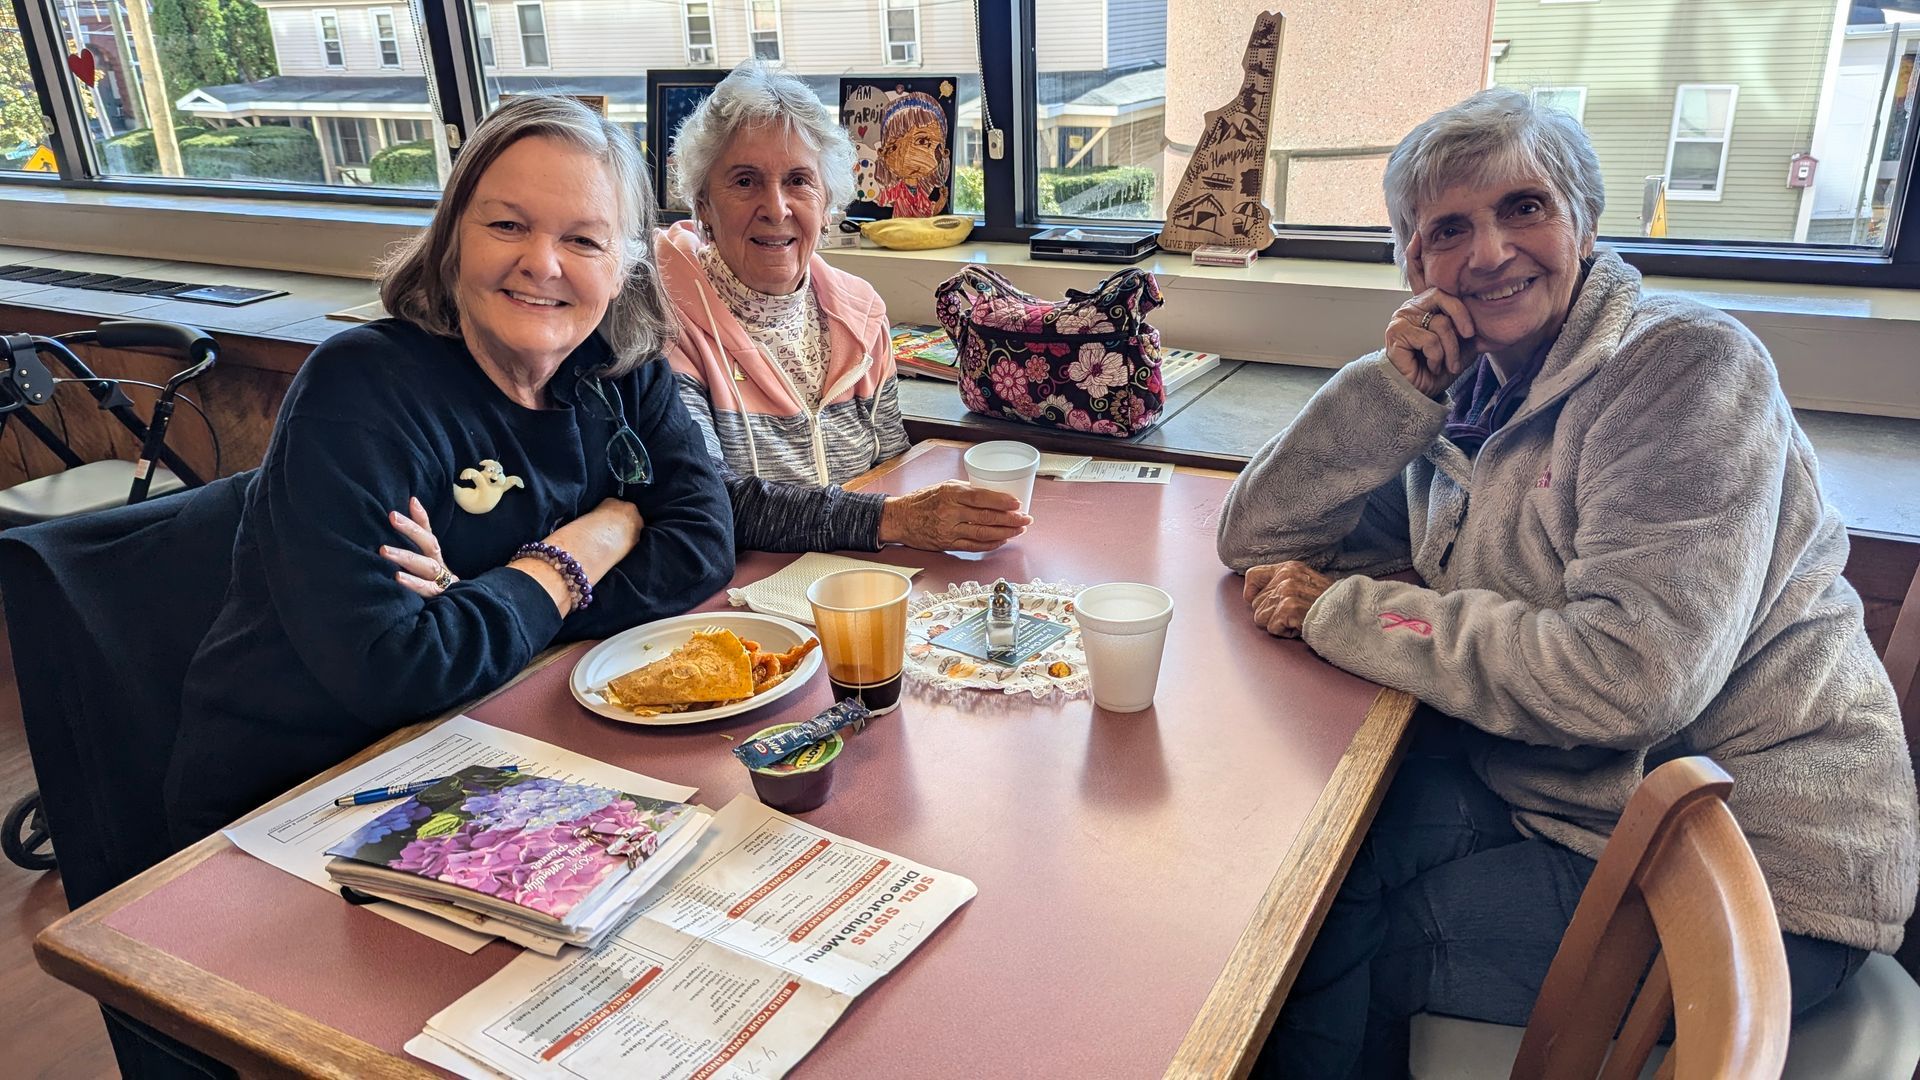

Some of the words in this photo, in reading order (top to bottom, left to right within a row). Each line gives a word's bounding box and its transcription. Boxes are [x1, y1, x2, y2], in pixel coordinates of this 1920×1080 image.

[856, 85, 872, 100] AM
[1165, 240, 1183, 250] LIVE
[1026, 641, 1042, 649] Out
[789, 835, 809, 849] Choose
[801, 844, 823, 859] BUILD
[529, 840, 569, 873] Planner
[783, 858, 806, 873] YOUR
[842, 854, 862, 869] Choose
[523, 858, 566, 894] Monthly
[766, 872, 788, 886] OWN
[861, 863, 884, 880] BUILD
[844, 878, 867, 894] YOUR
[887, 870, 920, 893] Dine
[897, 875, 936, 904] SOEL
[751, 885, 772, 898] SOEL
[828, 893, 849, 908] OWN
[730, 897, 756, 914] BOWL
[792, 894, 814, 909] Choose
[866, 892, 896, 912] Out
[792, 907, 834, 938] BREAKFAST
[839, 910, 875, 936] Club
[848, 906, 900, 946] SISTAS
[802, 934, 847, 964] Menu
[736, 978, 761, 998] Choose
[604, 991, 633, 1010] DAILY
[767, 988, 793, 1009] BUILD
[569, 1009, 612, 1036] SPECIALS
[710, 1002, 737, 1025] Protein:
[746, 1010, 771, 1030] YOUR
[643, 1019, 670, 1037] Choose
[618, 1037, 648, 1058] Cheese:
[685, 1038, 713, 1057] Choose
[725, 1031, 752, 1052] OWN
